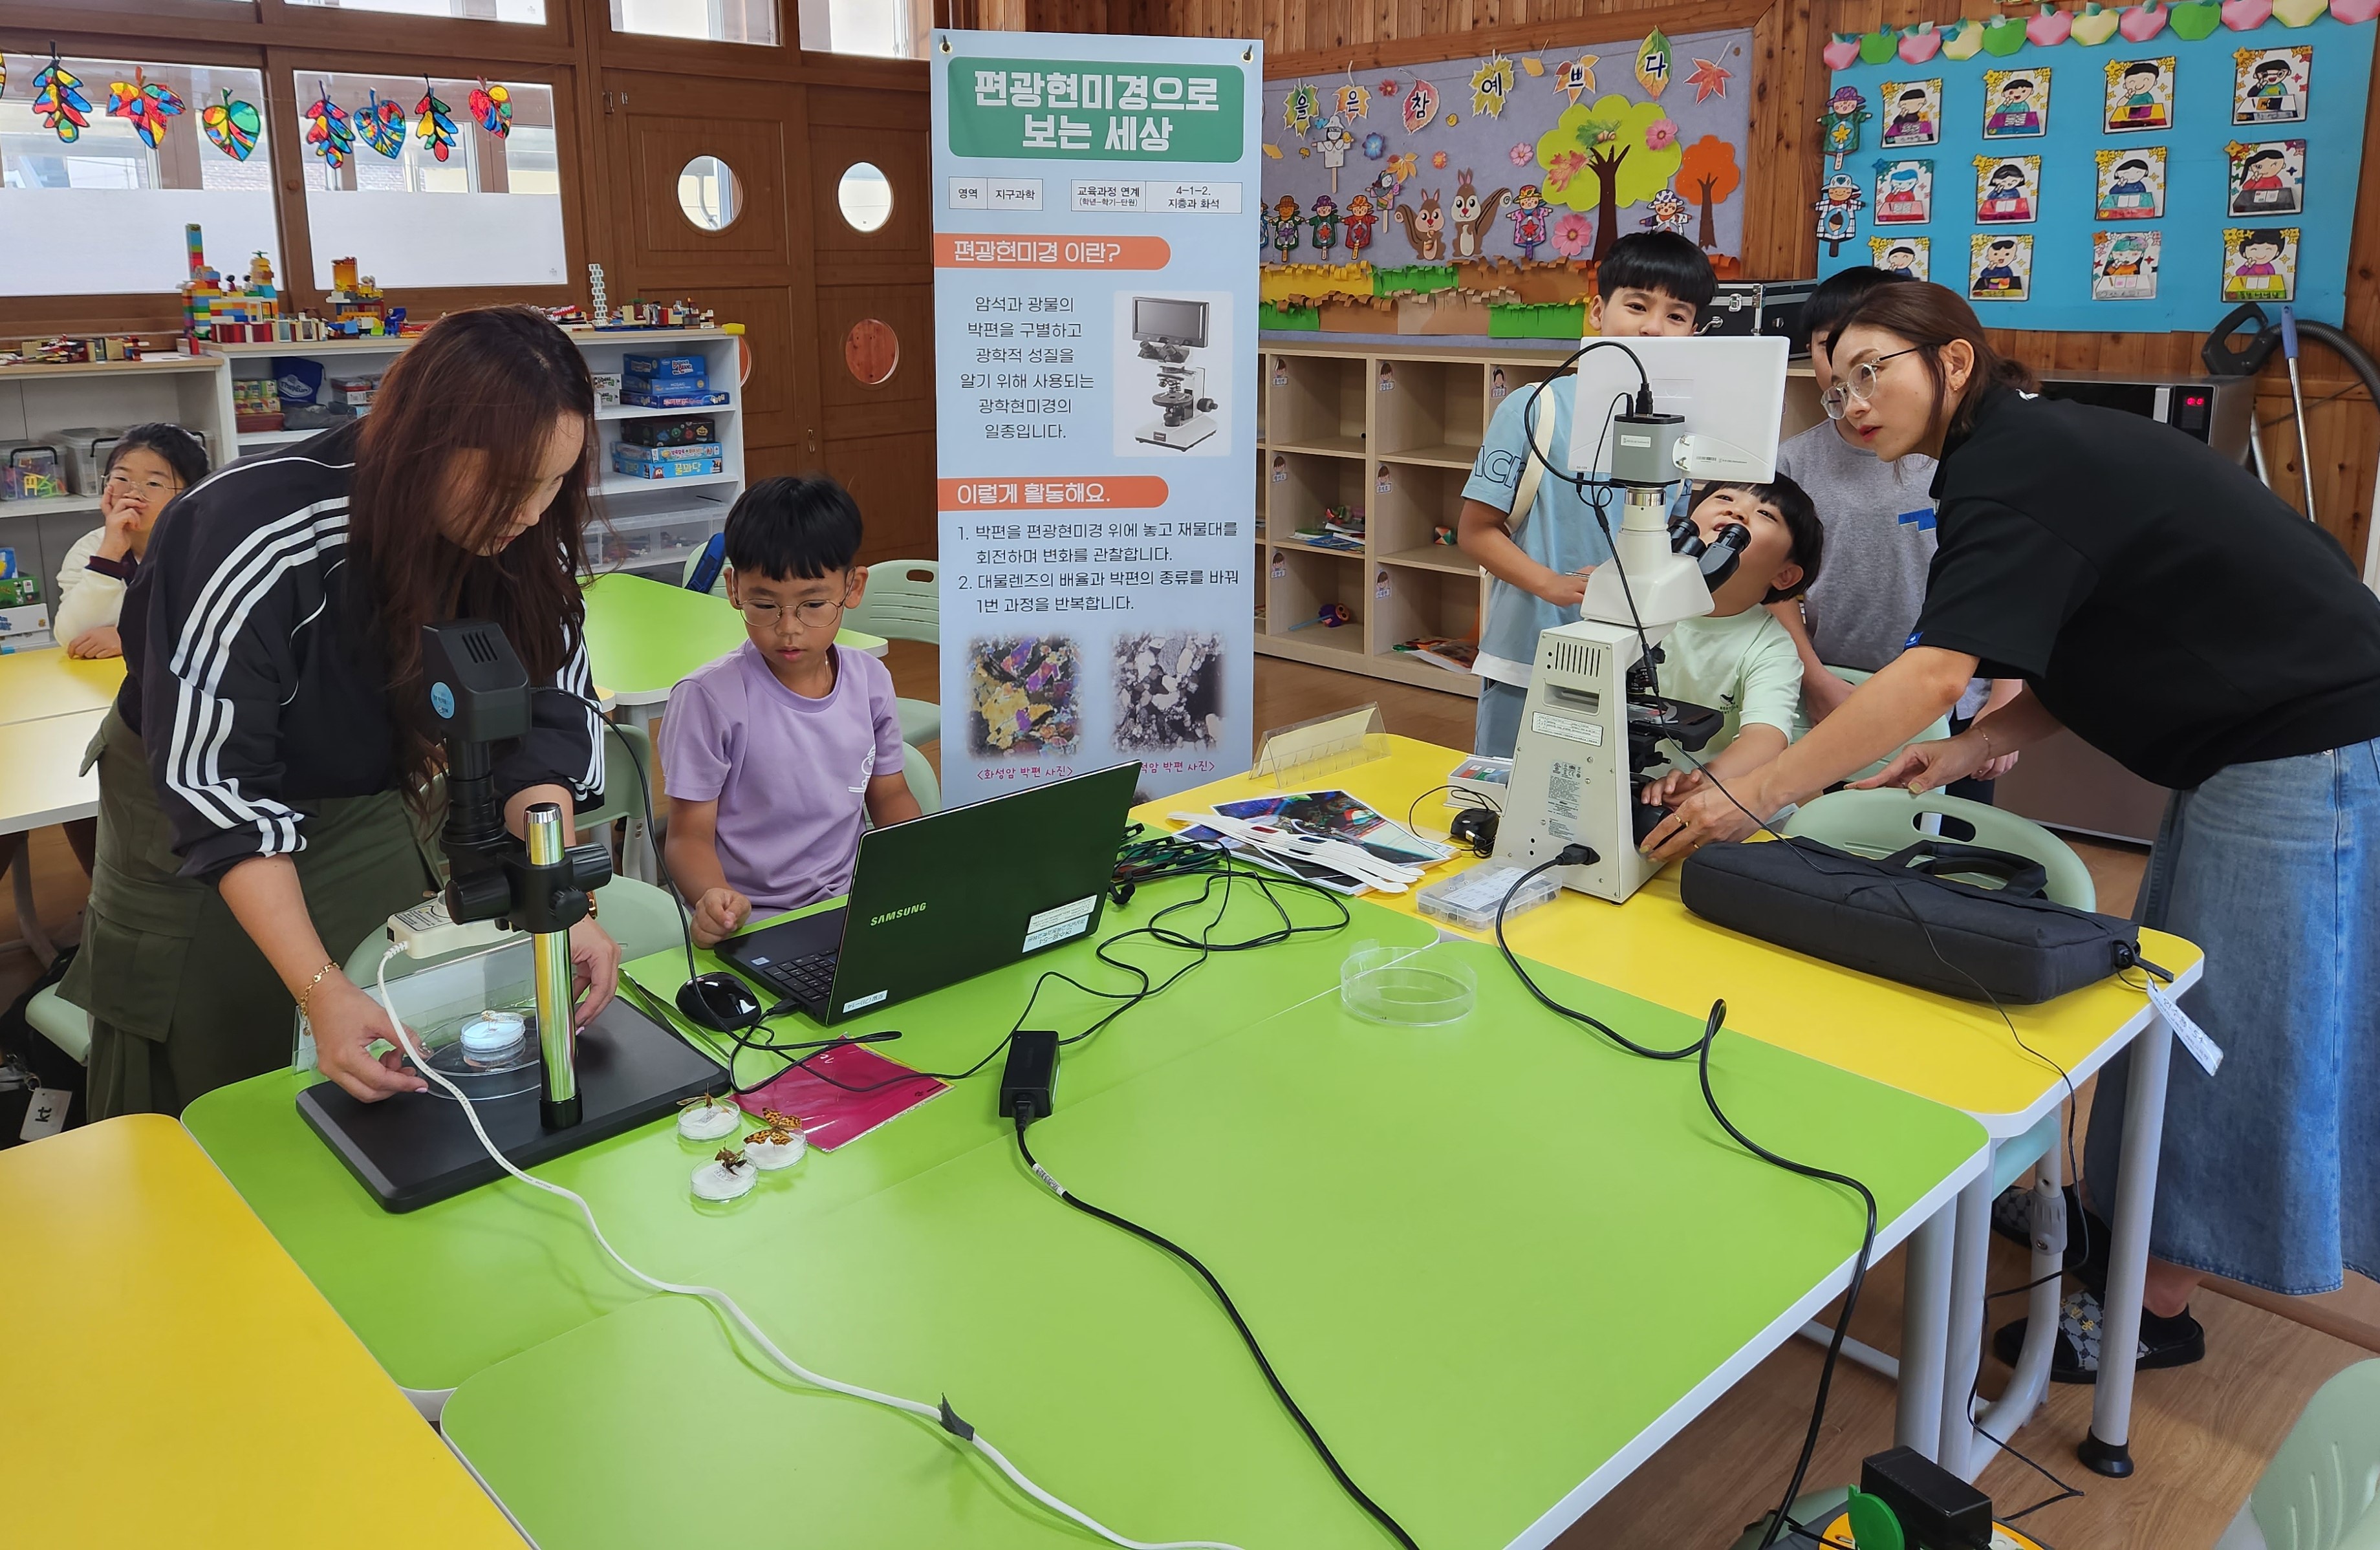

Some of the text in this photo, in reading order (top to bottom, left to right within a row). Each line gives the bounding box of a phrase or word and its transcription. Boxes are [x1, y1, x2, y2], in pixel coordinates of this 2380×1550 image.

[1646, 52, 1667, 78] 다
[975, 70, 1219, 111] 편광현미경으로
[1481, 72, 1502, 96] 예
[1295, 94, 1310, 120] 을
[1346, 90, 1359, 113] 은
[1412, 92, 1430, 119] 참
[1022, 114, 1173, 151] 보는 세상
[958, 188, 978, 199] 영역
[995, 189, 1035, 200] 지구과학
[1077, 186, 1140, 198] 교육과정 연계
[1176, 186, 1211, 196] 4-1-2.
[1079, 198, 1138, 207] (학년-학기-단원)
[1168, 199, 1220, 210] 지층과 화석
[954, 241, 1121, 263] 편광현미경 이란?
[975, 296, 1074, 313] 암석과 광물의
[968, 322, 1082, 338] 박편을 구별하고
[975, 347, 1074, 363] 광학적 성질을
[960, 373, 1094, 389] 알기 위해 사용되는
[979, 398, 1072, 414] 광학현미경의
[984, 424, 1066, 439] 일종입니다.
[957, 483, 1110, 504] 이렇게 활동해요.
[957, 521, 1238, 541] 1. 박편을 편광현미경 위에 놓고 재물대를
[976, 547, 1173, 565] 회전하며 변화를 관찰합니다.
[958, 570, 1239, 590] 2. 대물렌즈의 배율과 박편의 종류를 바꿔
[977, 596, 1134, 614] 1번 과정을 반복합니다.
[977, 766, 1073, 780] <화성암 박편 사진>
[1141, 760, 1215, 773] 적암 박편 사진>
[870, 902, 927, 926] SAMSUNG
[34, 1106, 52, 1123] kt
